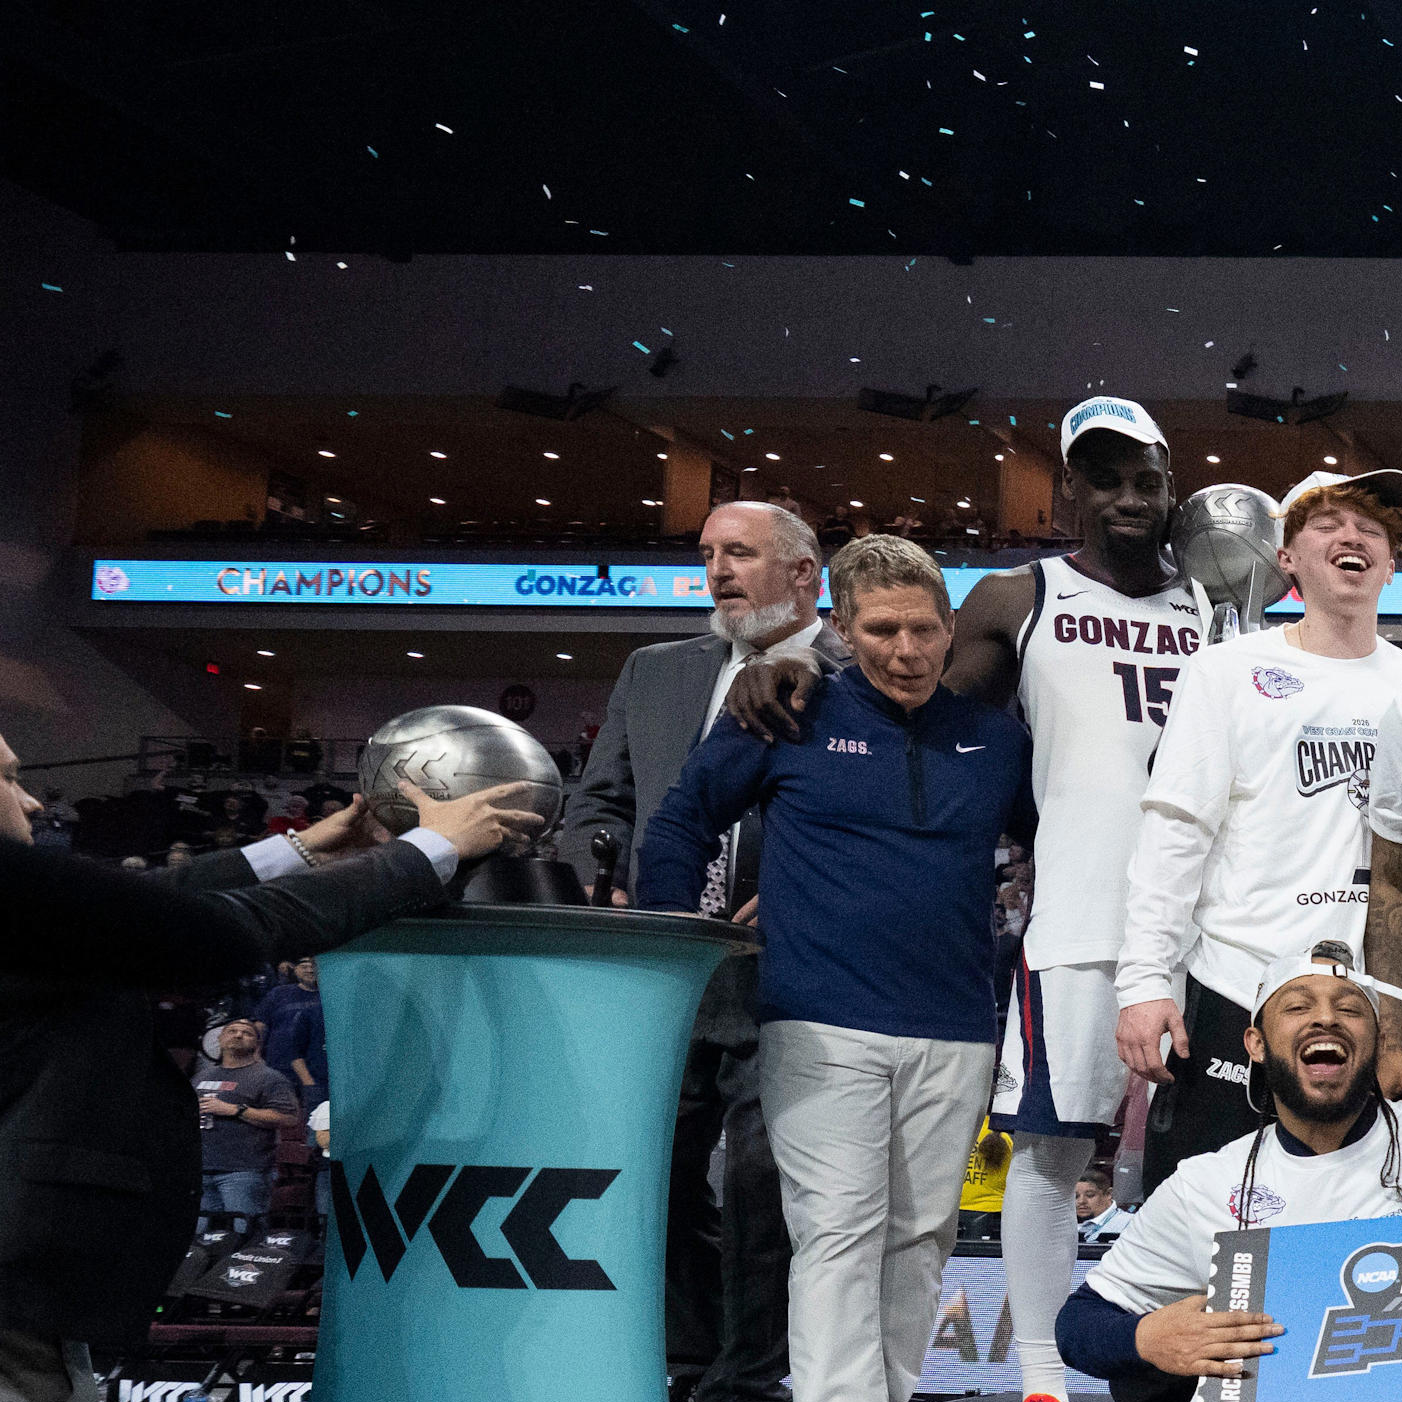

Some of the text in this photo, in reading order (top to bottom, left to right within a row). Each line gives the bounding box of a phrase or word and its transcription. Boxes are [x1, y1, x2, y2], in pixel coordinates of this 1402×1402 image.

[216, 567, 433, 597] CHAMPIONS
[515, 574, 658, 597] GONZAGA
[1054, 613, 1200, 656] GONZAG
[1112, 661, 1181, 728] 15
[1352, 719, 1370, 727] 2026
[827, 737, 868, 755] ZAGS
[1297, 740, 1376, 788] CHAMP
[1296, 890, 1369, 905] GONZAG
[1206, 1057, 1251, 1086] ZAGS
[963, 1171, 988, 1186] AFF
[330, 1160, 621, 1291] WCC
[266, 1236, 294, 1246] WCC
[229, 1268, 260, 1282] WCC
[1356, 1270, 1397, 1283] NCAA
